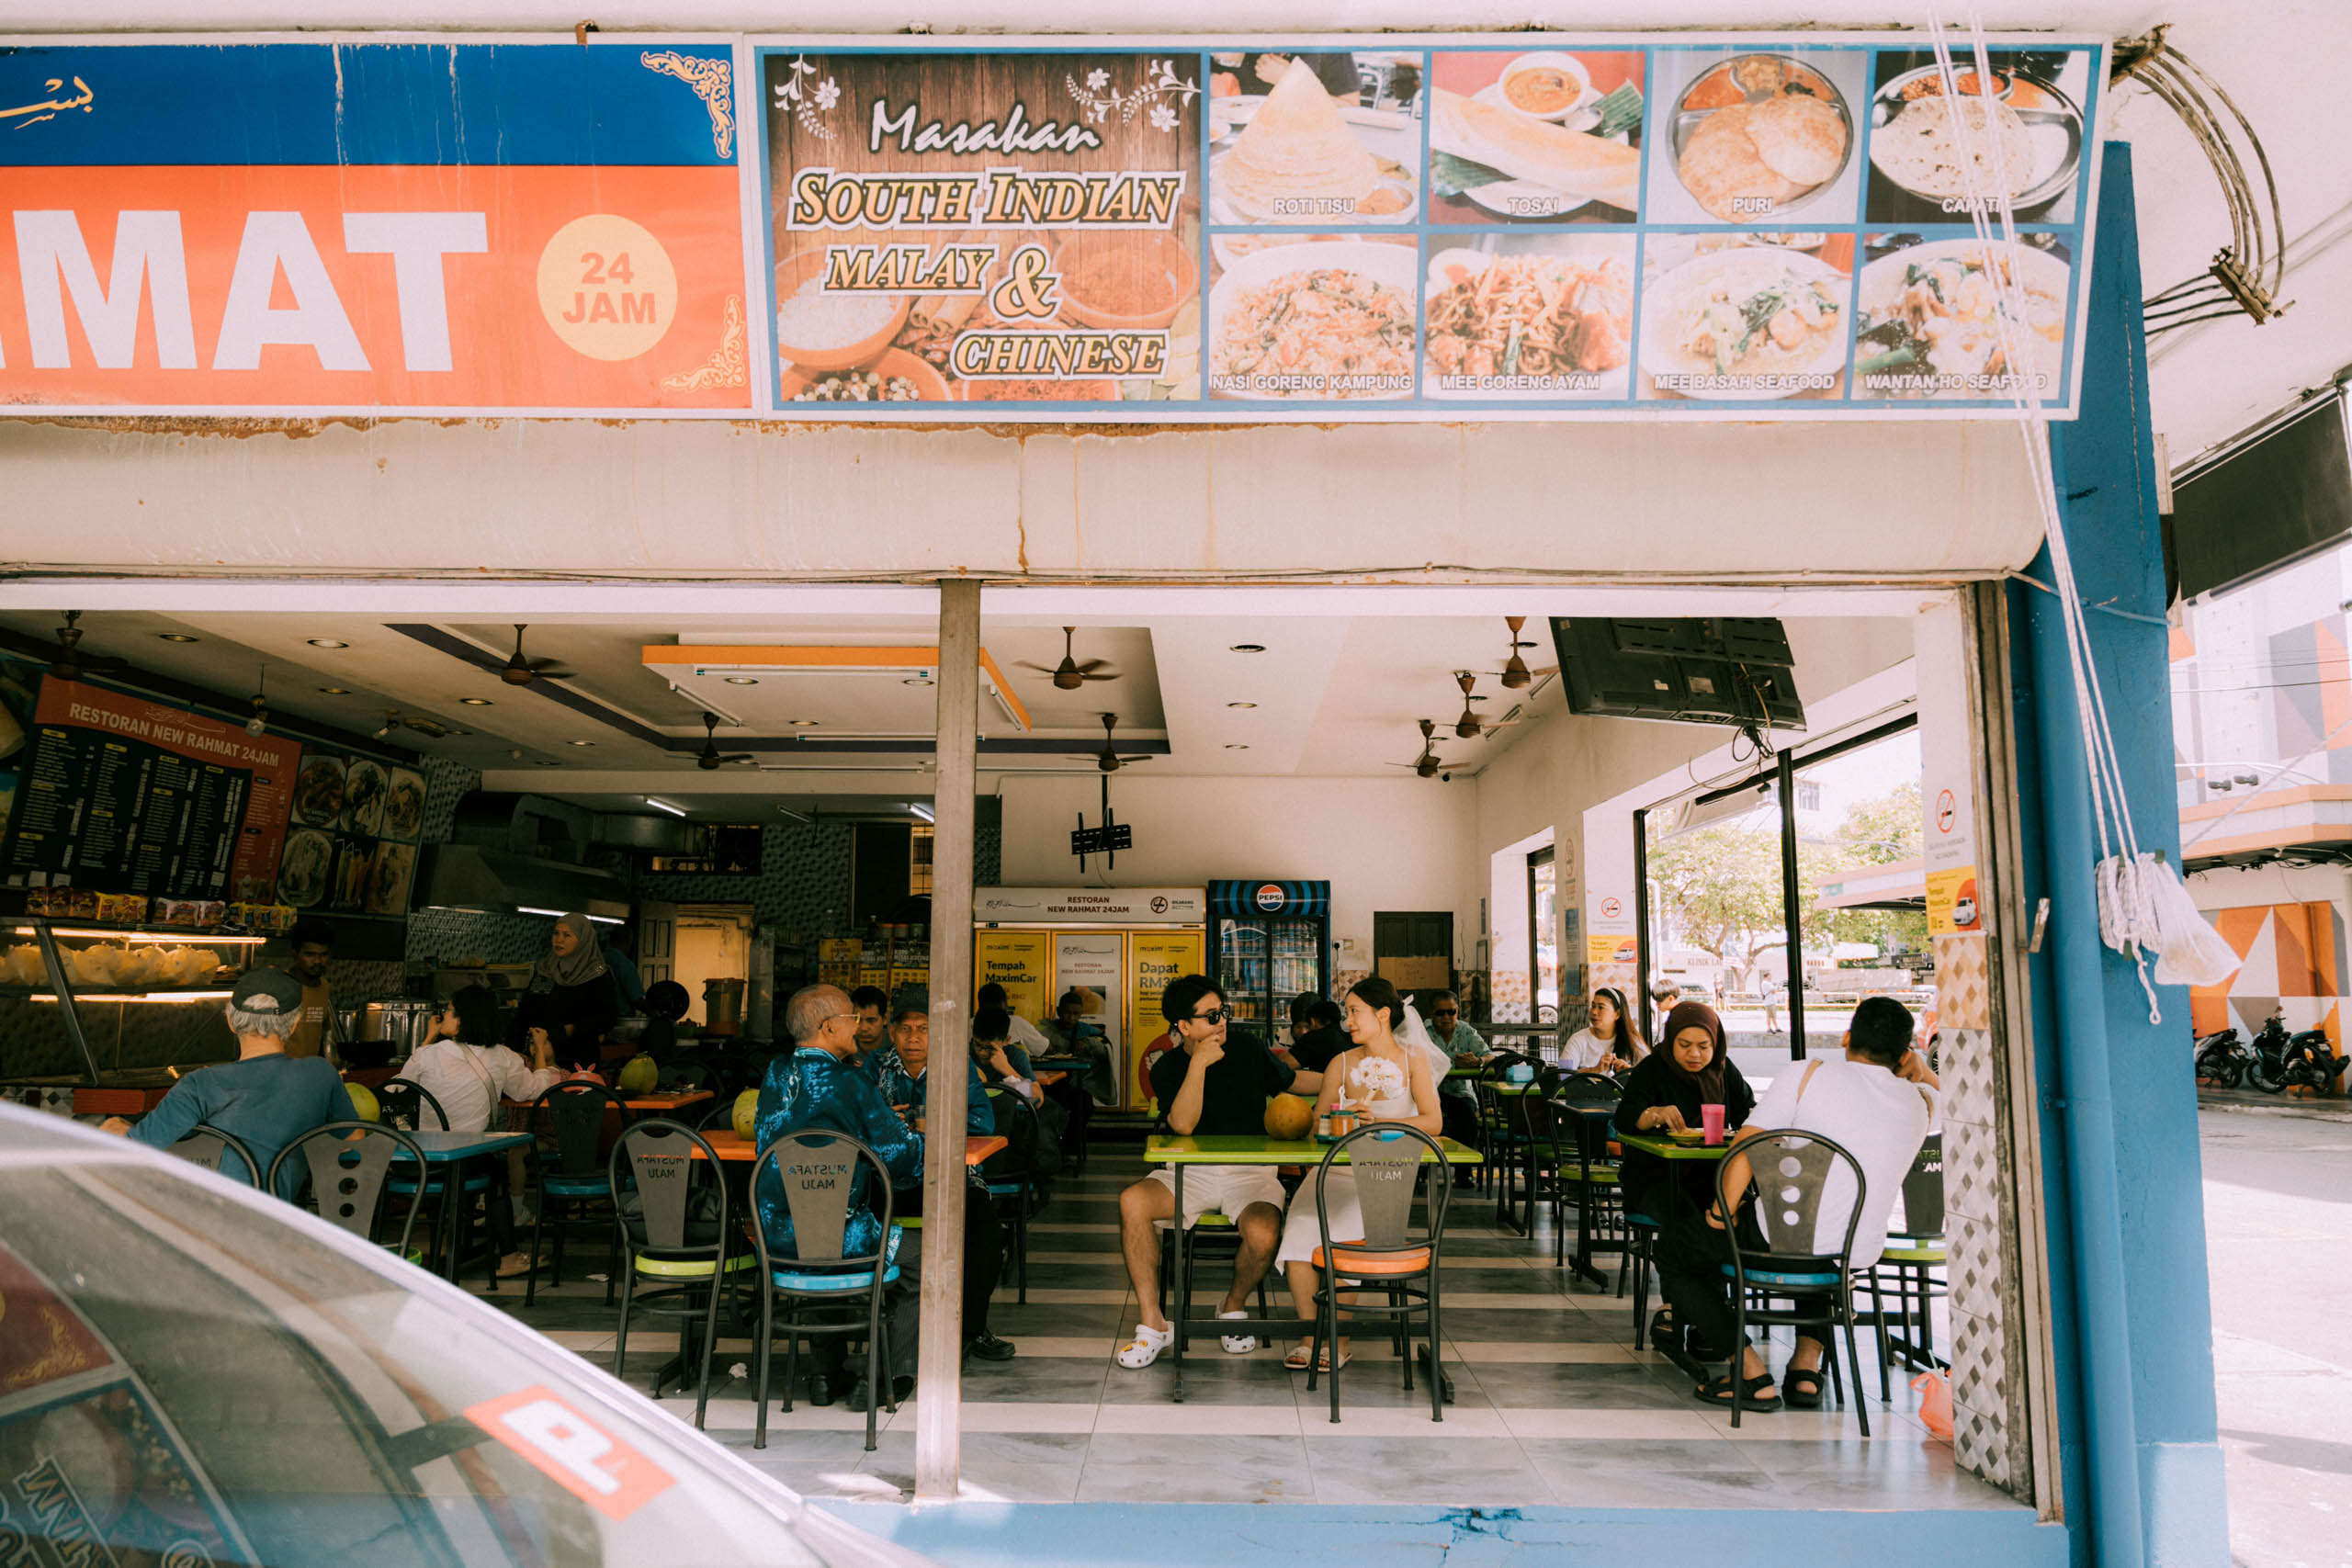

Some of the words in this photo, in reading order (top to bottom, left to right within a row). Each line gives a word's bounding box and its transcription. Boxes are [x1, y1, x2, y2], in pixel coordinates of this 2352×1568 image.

[869, 99, 1101, 153] Masakan
[791, 171, 979, 226] SOUTH
[982, 172, 1182, 226] INDIAN
[1273, 198, 1314, 214] ROTI
[1317, 198, 1355, 214] TISU
[1508, 197, 1559, 214] TOSAI
[1733, 197, 1772, 213] PURI
[580, 252, 634, 286] 24
[0, 209, 489, 373] MAT
[824, 247, 995, 291] MALAY
[993, 247, 1058, 319] &
[561, 290, 657, 325] JAM
[954, 333, 1167, 377] CHINESE
[1212, 375, 1251, 390] NASI
[1254, 375, 1326, 390] GORENG
[1329, 375, 1413, 390] KAMPUNG
[1441, 375, 1477, 390] MEE
[1480, 375, 1553, 390] GORENG
[1554, 375, 1600, 390] AYAM
[1654, 374, 1691, 389] MEE
[1694, 374, 1751, 389] BASAH
[1755, 374, 1836, 389] SEAFOOD
[1865, 374, 1936, 389] WANTAN
[1939, 374, 1963, 389] HO
[69, 702, 149, 737] RESTORAN
[153, 724, 184, 745] NEW
[186, 732, 240, 759] RAHMAT
[241, 745, 279, 767] 24JAM
[1067, 896, 1110, 904] RESTORAN
[1046, 906, 1066, 914] NEW
[1067, 906, 1102, 914] RAHMAT
[1102, 906, 1130, 914] 24JAM
[987, 961, 1025, 971] Tempah
[1140, 963, 1179, 975] Dapat
[985, 974, 1037, 983] MaximCar
